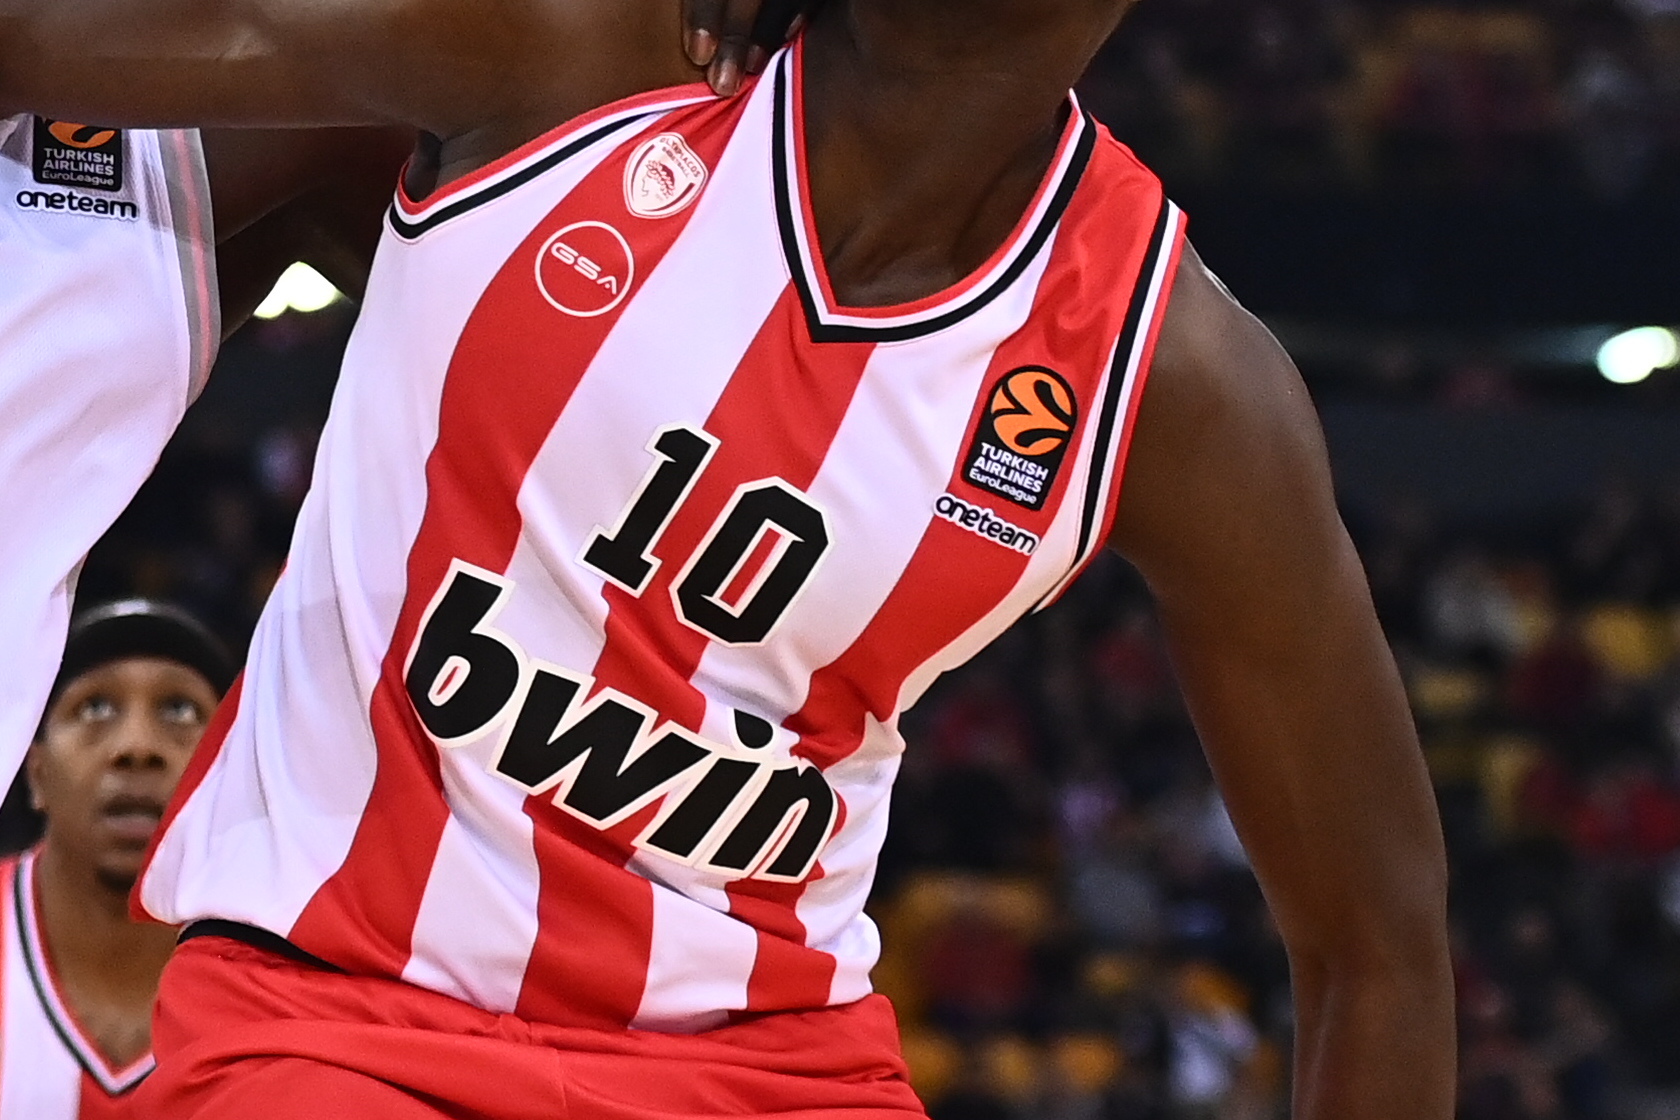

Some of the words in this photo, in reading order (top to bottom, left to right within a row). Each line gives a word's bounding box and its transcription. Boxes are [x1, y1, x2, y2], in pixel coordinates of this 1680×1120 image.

[43, 160, 114, 176] AIRLINES
[44, 147, 114, 165] TURKISH
[42, 170, 114, 186] EuroLeague
[16, 190, 138, 219] oneteam
[551, 242, 617, 295] GSA
[973, 456, 1043, 493] AIRLINES
[981, 442, 1049, 481] TURKISH
[969, 468, 1037, 505] EuroLeague
[579, 425, 831, 645] 10
[935, 495, 1037, 554] oneteam
[404, 564, 836, 880] bwin
